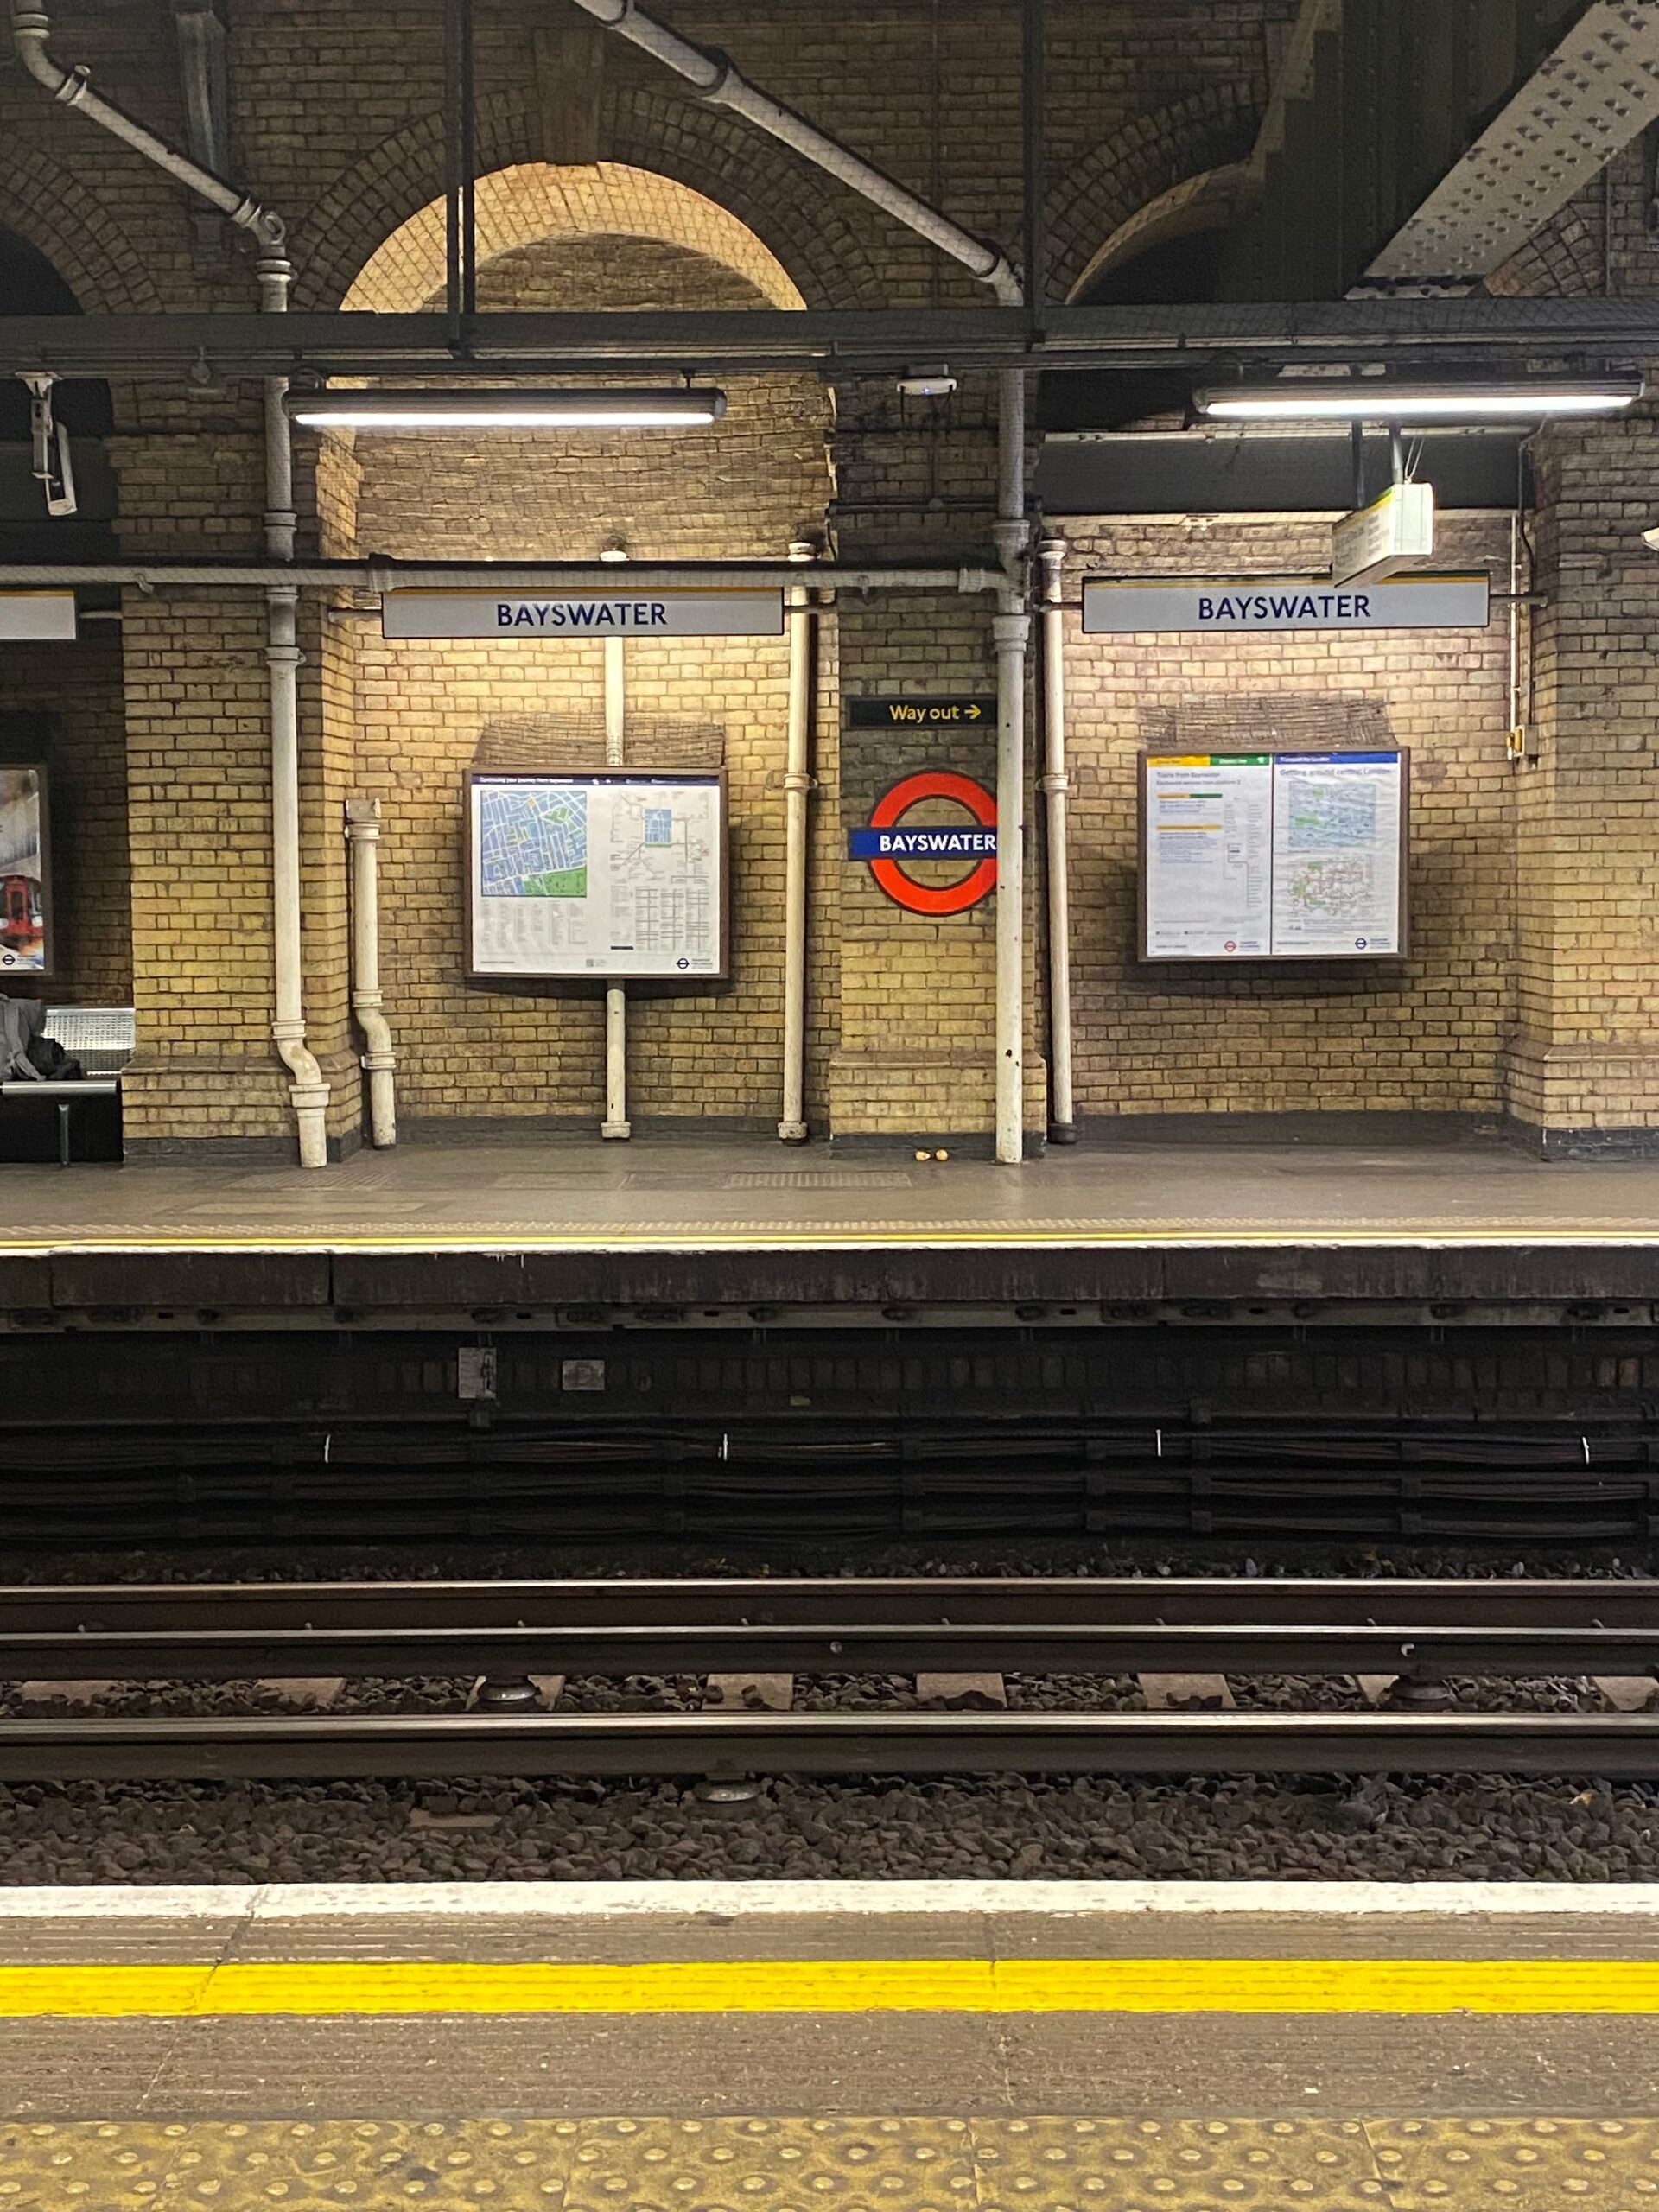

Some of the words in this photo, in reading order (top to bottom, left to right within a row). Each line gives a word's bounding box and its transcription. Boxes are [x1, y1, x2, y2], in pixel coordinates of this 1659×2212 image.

[498, 603, 668, 626] BAYSWATER
[1198, 595, 1371, 620] BAYSWATER
[889, 704, 926, 723] Way
[929, 705, 960, 720] out
[880, 834, 997, 852] BAYSWATER
